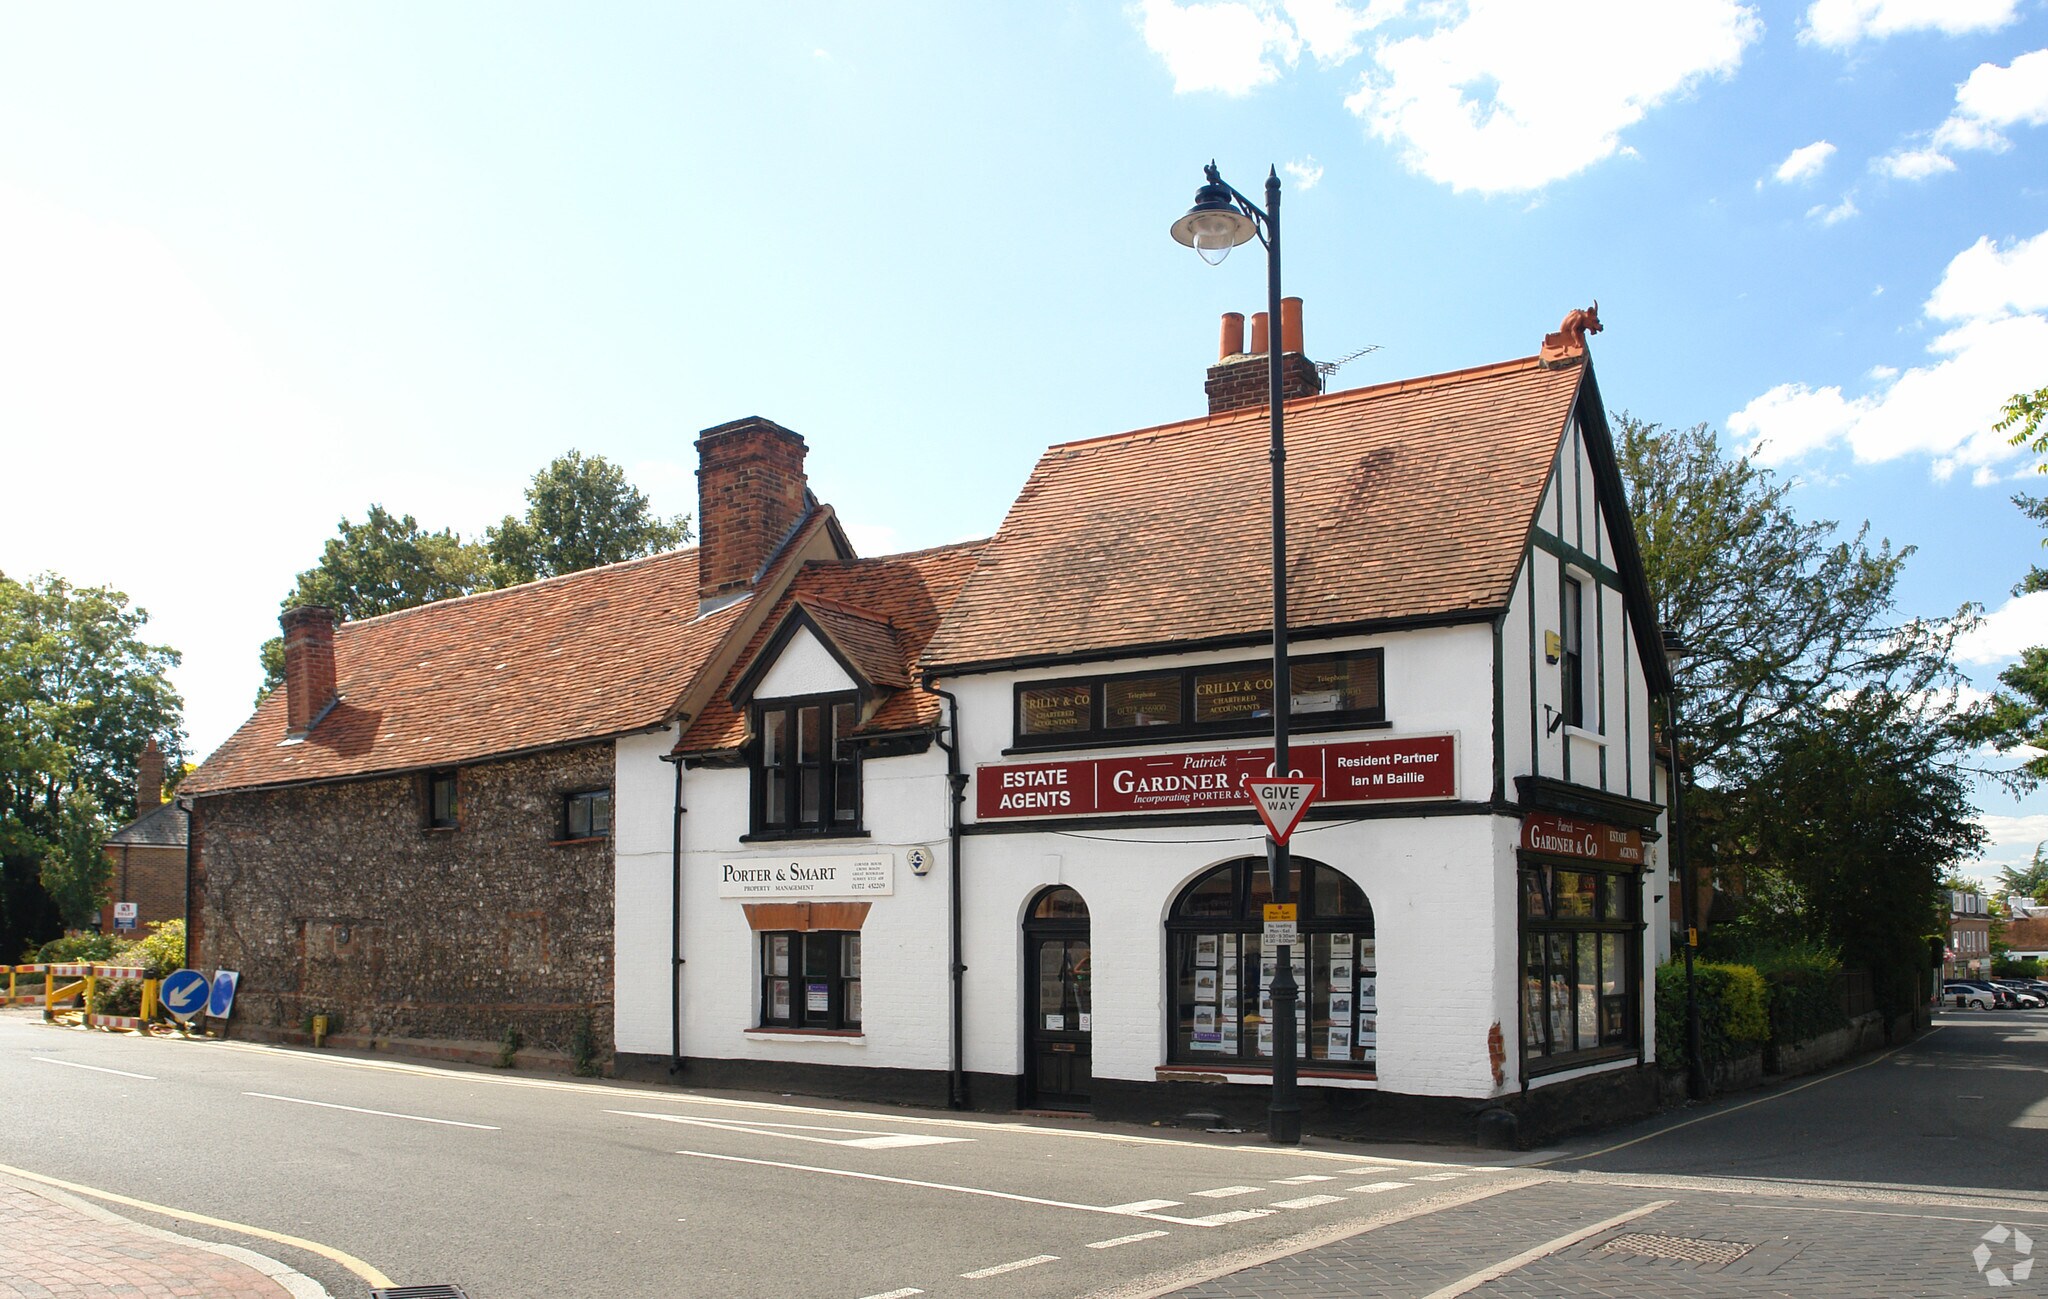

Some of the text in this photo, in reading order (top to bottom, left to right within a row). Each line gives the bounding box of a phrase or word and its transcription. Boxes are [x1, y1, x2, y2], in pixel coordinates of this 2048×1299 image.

[1196, 678, 1274, 696] CRILLY & CO
[1063, 697, 1071, 706] &
[1074, 695, 1090, 705] CO
[1213, 695, 1257, 704] CHARTERED
[1036, 710, 1075, 719] CHARTERED
[1209, 703, 1261, 713] ACCOUNTANTS
[1033, 718, 1078, 727] ACCOUNTANTS
[1183, 754, 1227, 769] Patrick
[1337, 752, 1440, 768] Resident Partner
[1003, 769, 1068, 788] ESTATE
[1113, 770, 1229, 794] GARDNER
[1351, 772, 1425, 786] Ian M Baillie
[999, 790, 1071, 810] AGENTS
[1133, 792, 1191, 805] Incorporating
[1193, 790, 1232, 801] PORTER
[1234, 790, 1241, 799] &
[1261, 786, 1300, 800] GIVE
[1268, 801, 1296, 811] WAY
[1609, 830, 1628, 844] ESTATE
[1576, 840, 1583, 854] &
[1619, 847, 1639, 859] AGENTS
[722, 862, 837, 882] PORTER & SMART
[775, 884, 815, 892] MANAGEMENT
